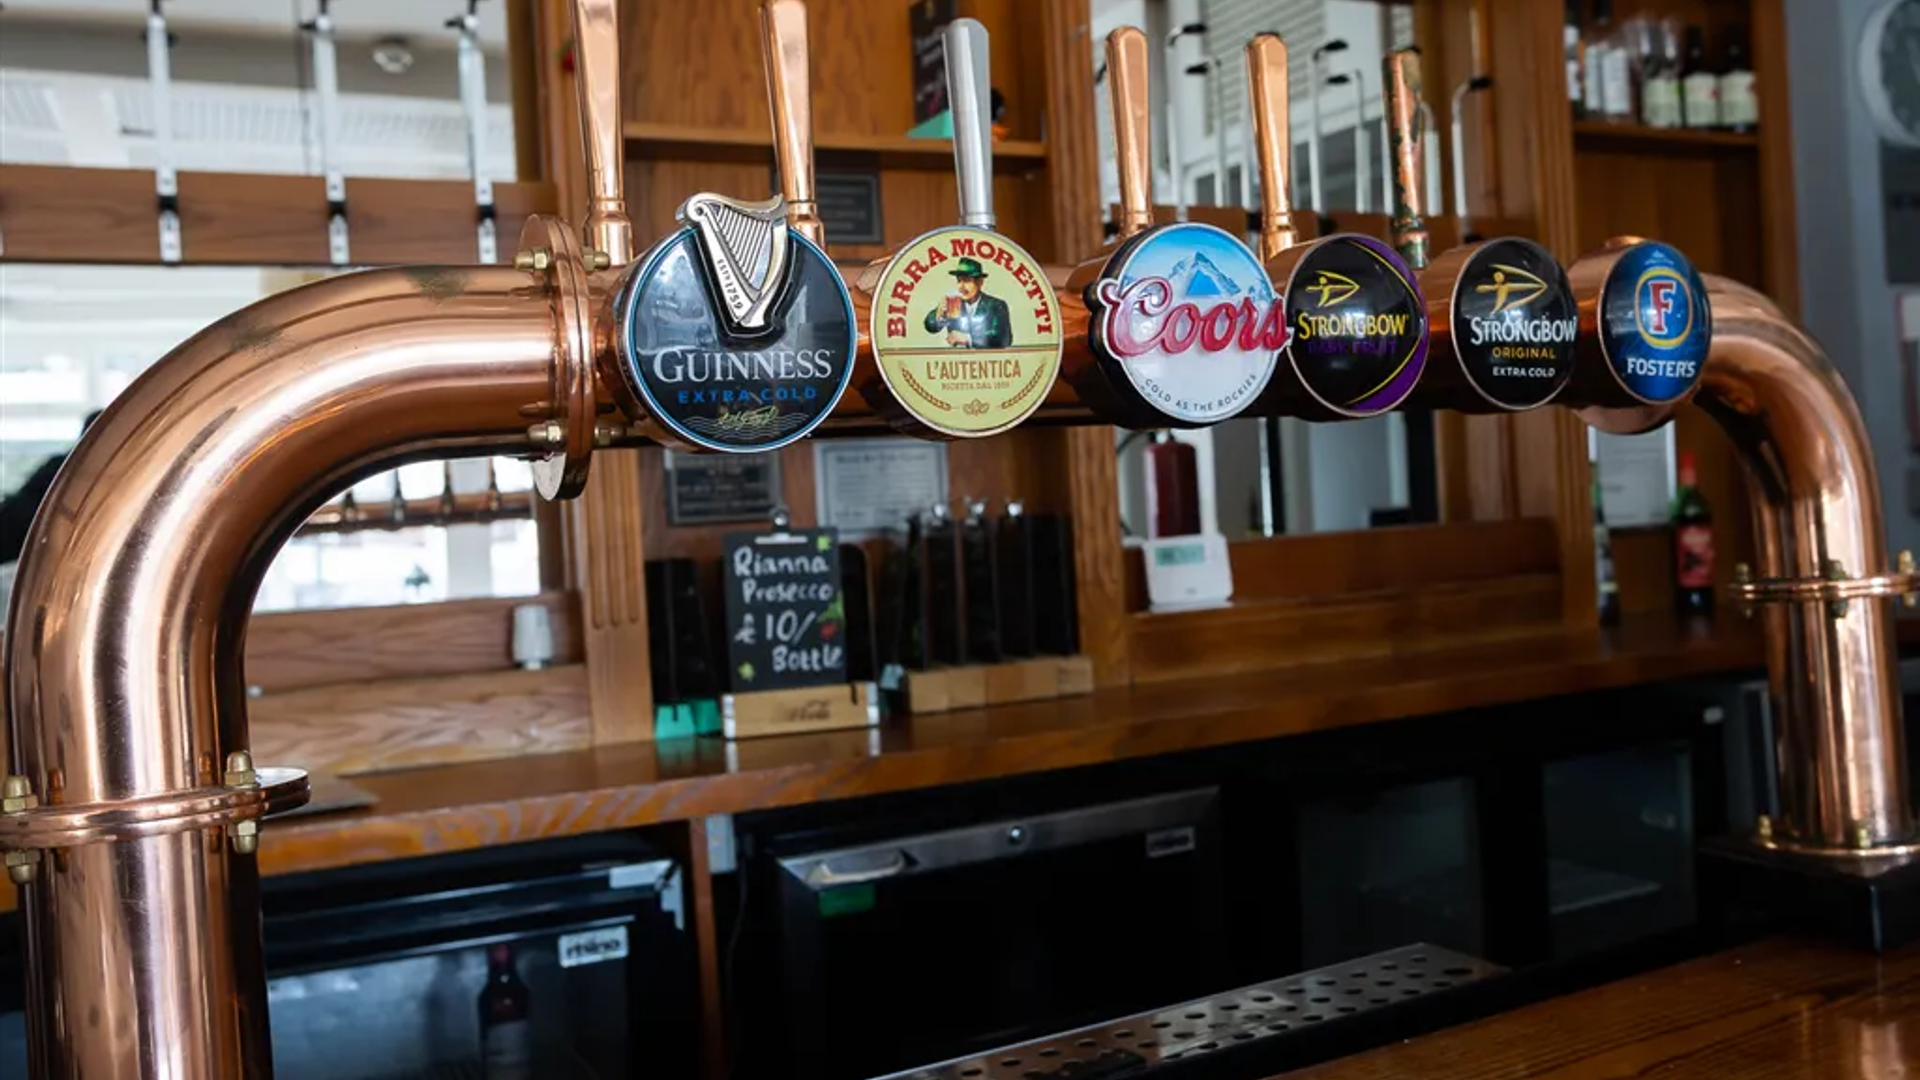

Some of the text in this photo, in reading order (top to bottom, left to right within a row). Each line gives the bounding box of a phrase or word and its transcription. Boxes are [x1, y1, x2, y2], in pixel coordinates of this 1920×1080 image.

[724, 281, 744, 309] 1759
[887, 238, 1052, 339] BIRRA MORETTI
[1100, 277, 1291, 357] Coors
[1648, 280, 1676, 335] F
[1298, 312, 1407, 340] STRONGBOW
[1470, 316, 1577, 346] STRONGBOW
[653, 350, 832, 382] GUINNESS
[1492, 347, 1557, 360] ORIGINAL
[1626, 357, 1696, 378] FOSTER'S
[926, 359, 1021, 380] L'AUTENTICA
[1492, 366, 1556, 378] EXTRA COLD
[678, 387, 818, 404] EXTRA COLD
[1145, 378, 1172, 403] COLD
[1175, 400, 1188, 410] AS
[1193, 402, 1213, 412] THE
[733, 546, 830, 577] Rianna
[741, 578, 833, 603] Prosecco
[772, 645, 843, 672] Bottle
